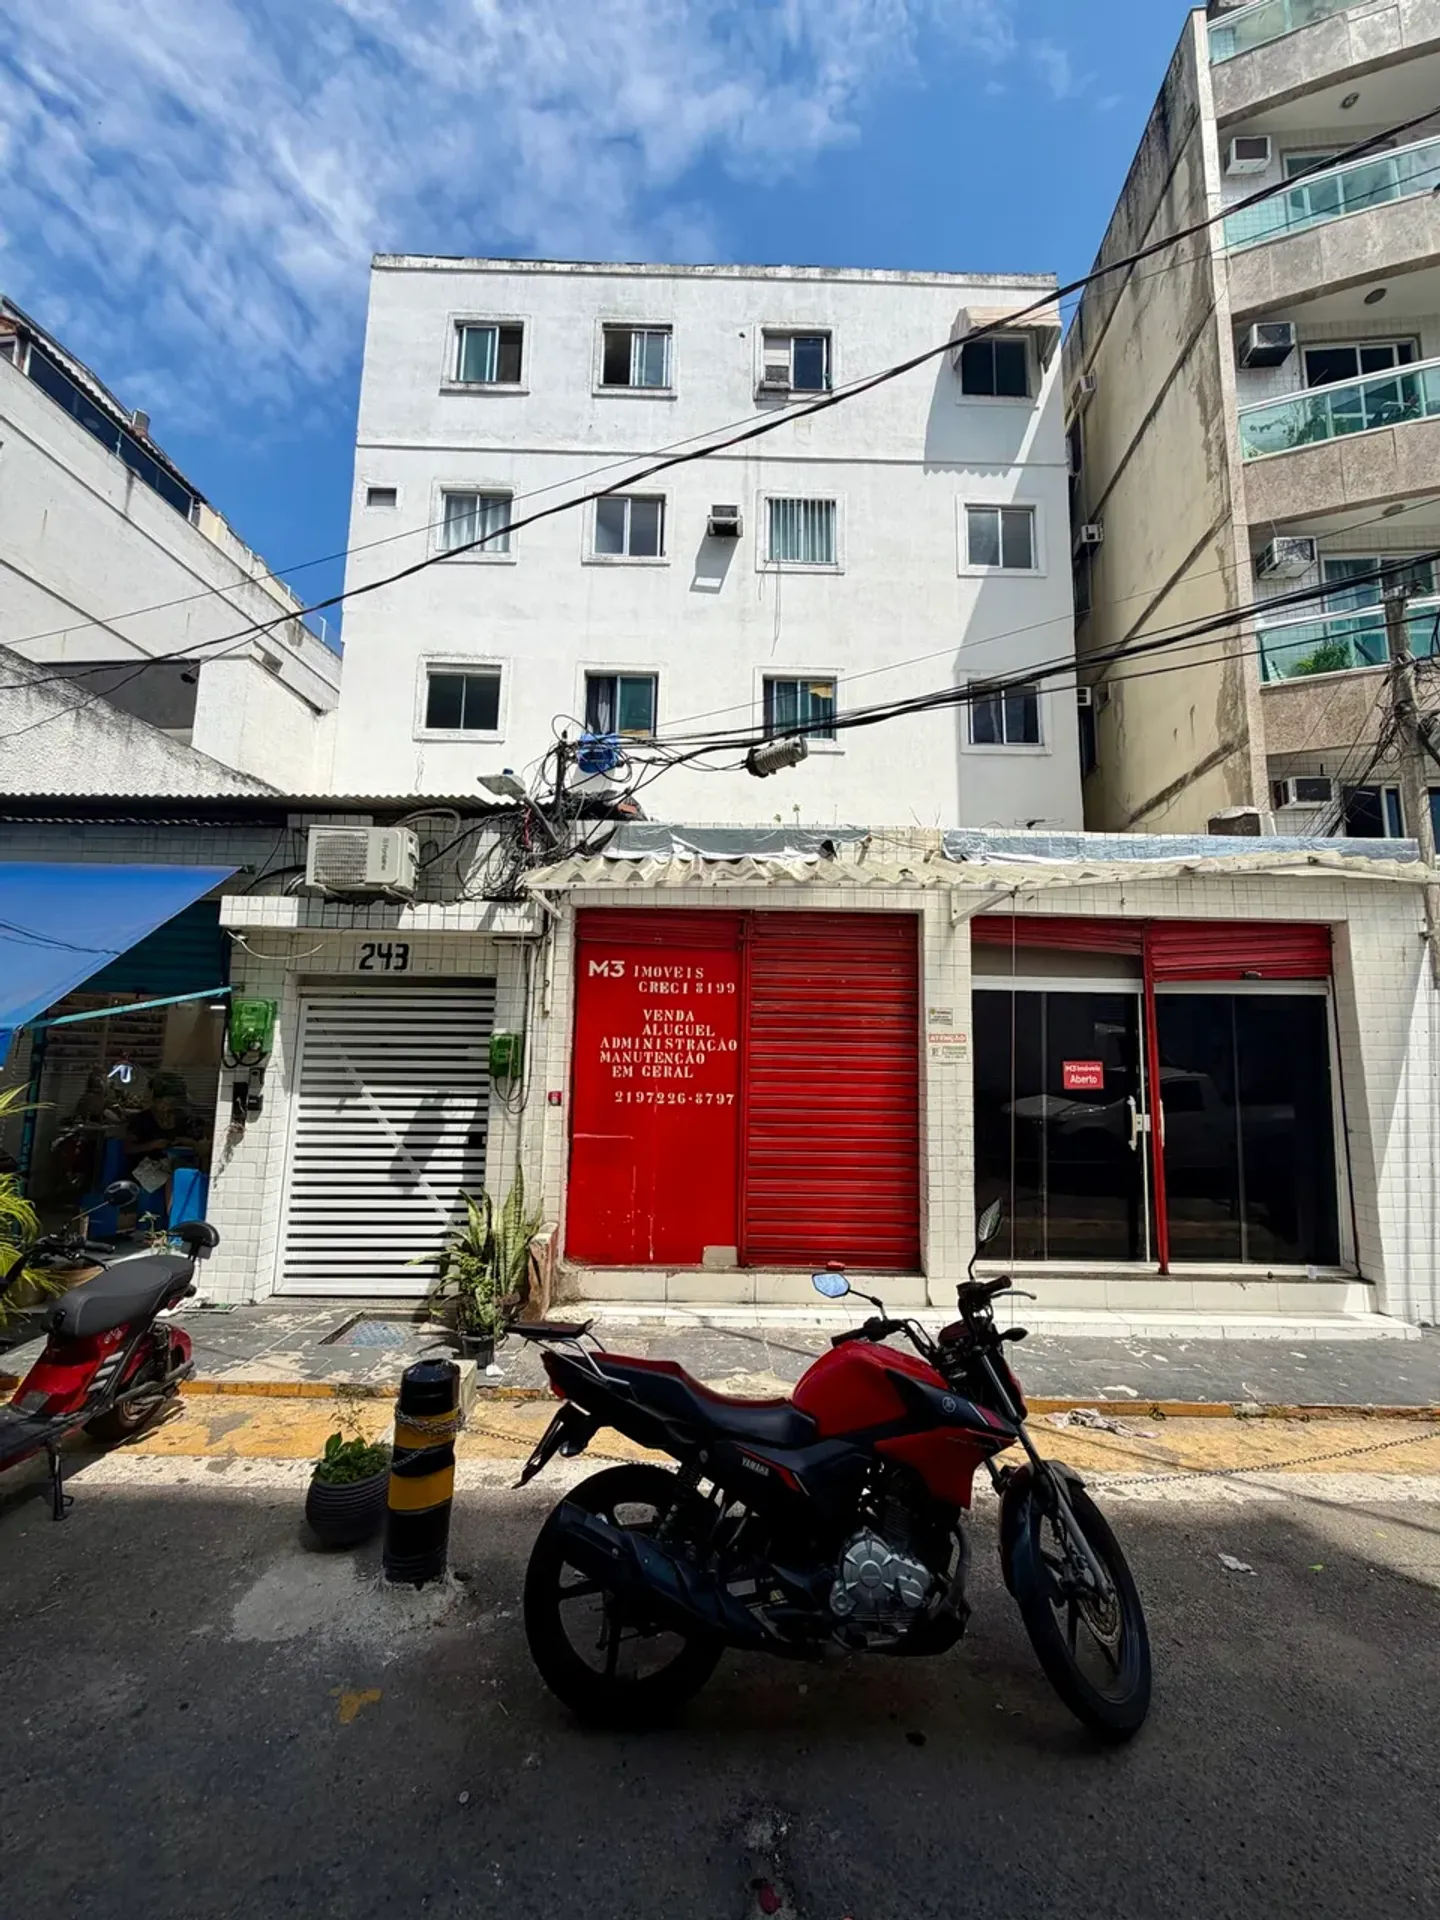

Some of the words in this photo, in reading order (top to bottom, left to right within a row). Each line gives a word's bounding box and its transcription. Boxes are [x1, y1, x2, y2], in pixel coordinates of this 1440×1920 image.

[359, 943, 409, 970] 243
[588, 960, 625, 977] M3
[638, 981, 688, 994] CRECI
[695, 983, 735, 994] 8199
[643, 1009, 694, 1021] VENDA
[642, 1024, 715, 1036] ALUGUEL
[612, 1065, 633, 1078] EM
[641, 1066, 693, 1078] GERAL
[1070, 1075, 1097, 1084] Aberto
